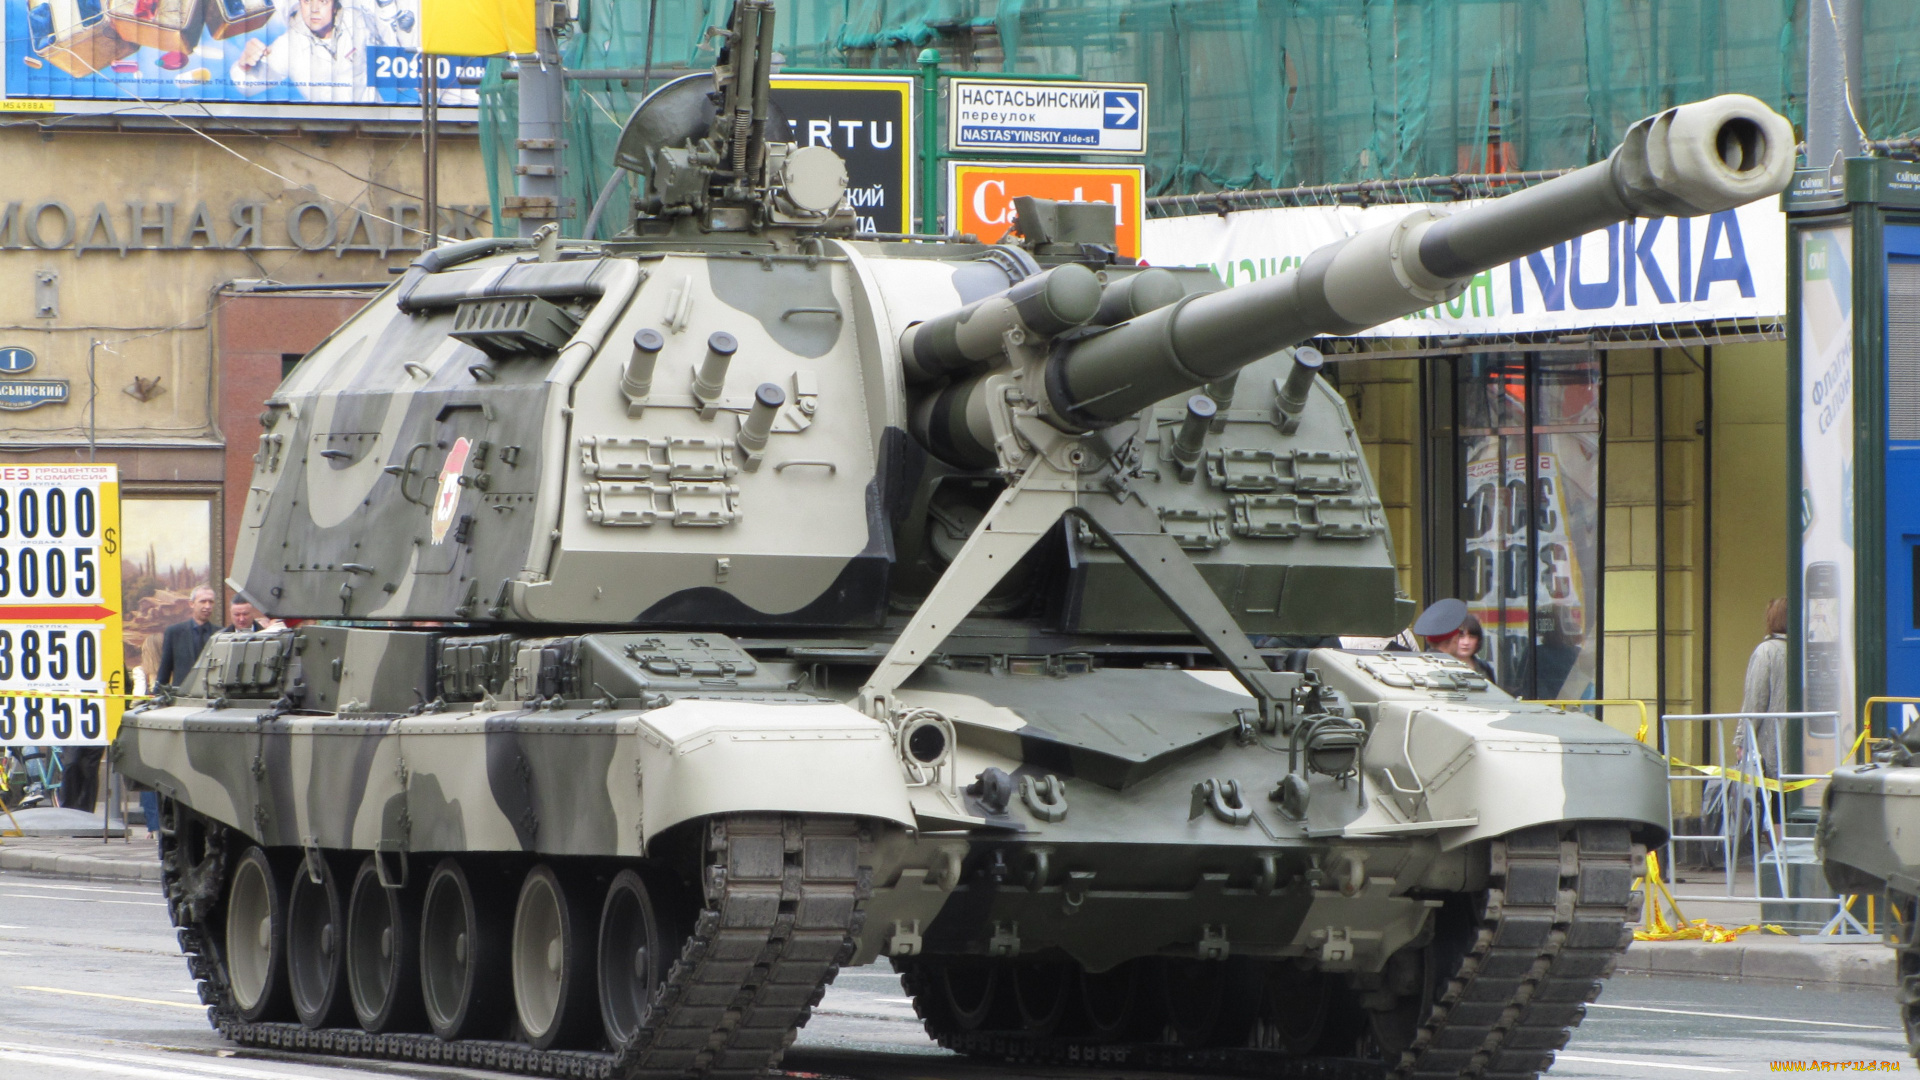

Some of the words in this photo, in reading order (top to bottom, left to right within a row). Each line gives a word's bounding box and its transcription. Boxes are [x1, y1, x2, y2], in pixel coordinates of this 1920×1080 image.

[962, 89, 1100, 109] НАСТАСЬИНСКИЙ
[962, 111, 1036, 124] переулок
[963, 129, 1061, 143] NASTAS'YINSKIY
[1062, 134, 1097, 144] side-st.
[1510, 208, 1756, 315] NOKIA
[9, 350, 17, 369] 1
[0, 384, 63, 397] СЬИНСКИЙ
[0, 468, 30, 481] ЕЗ
[104, 527, 117, 557] $
[0, 629, 97, 681] 3850
[0, 689, 101, 741] 3855
